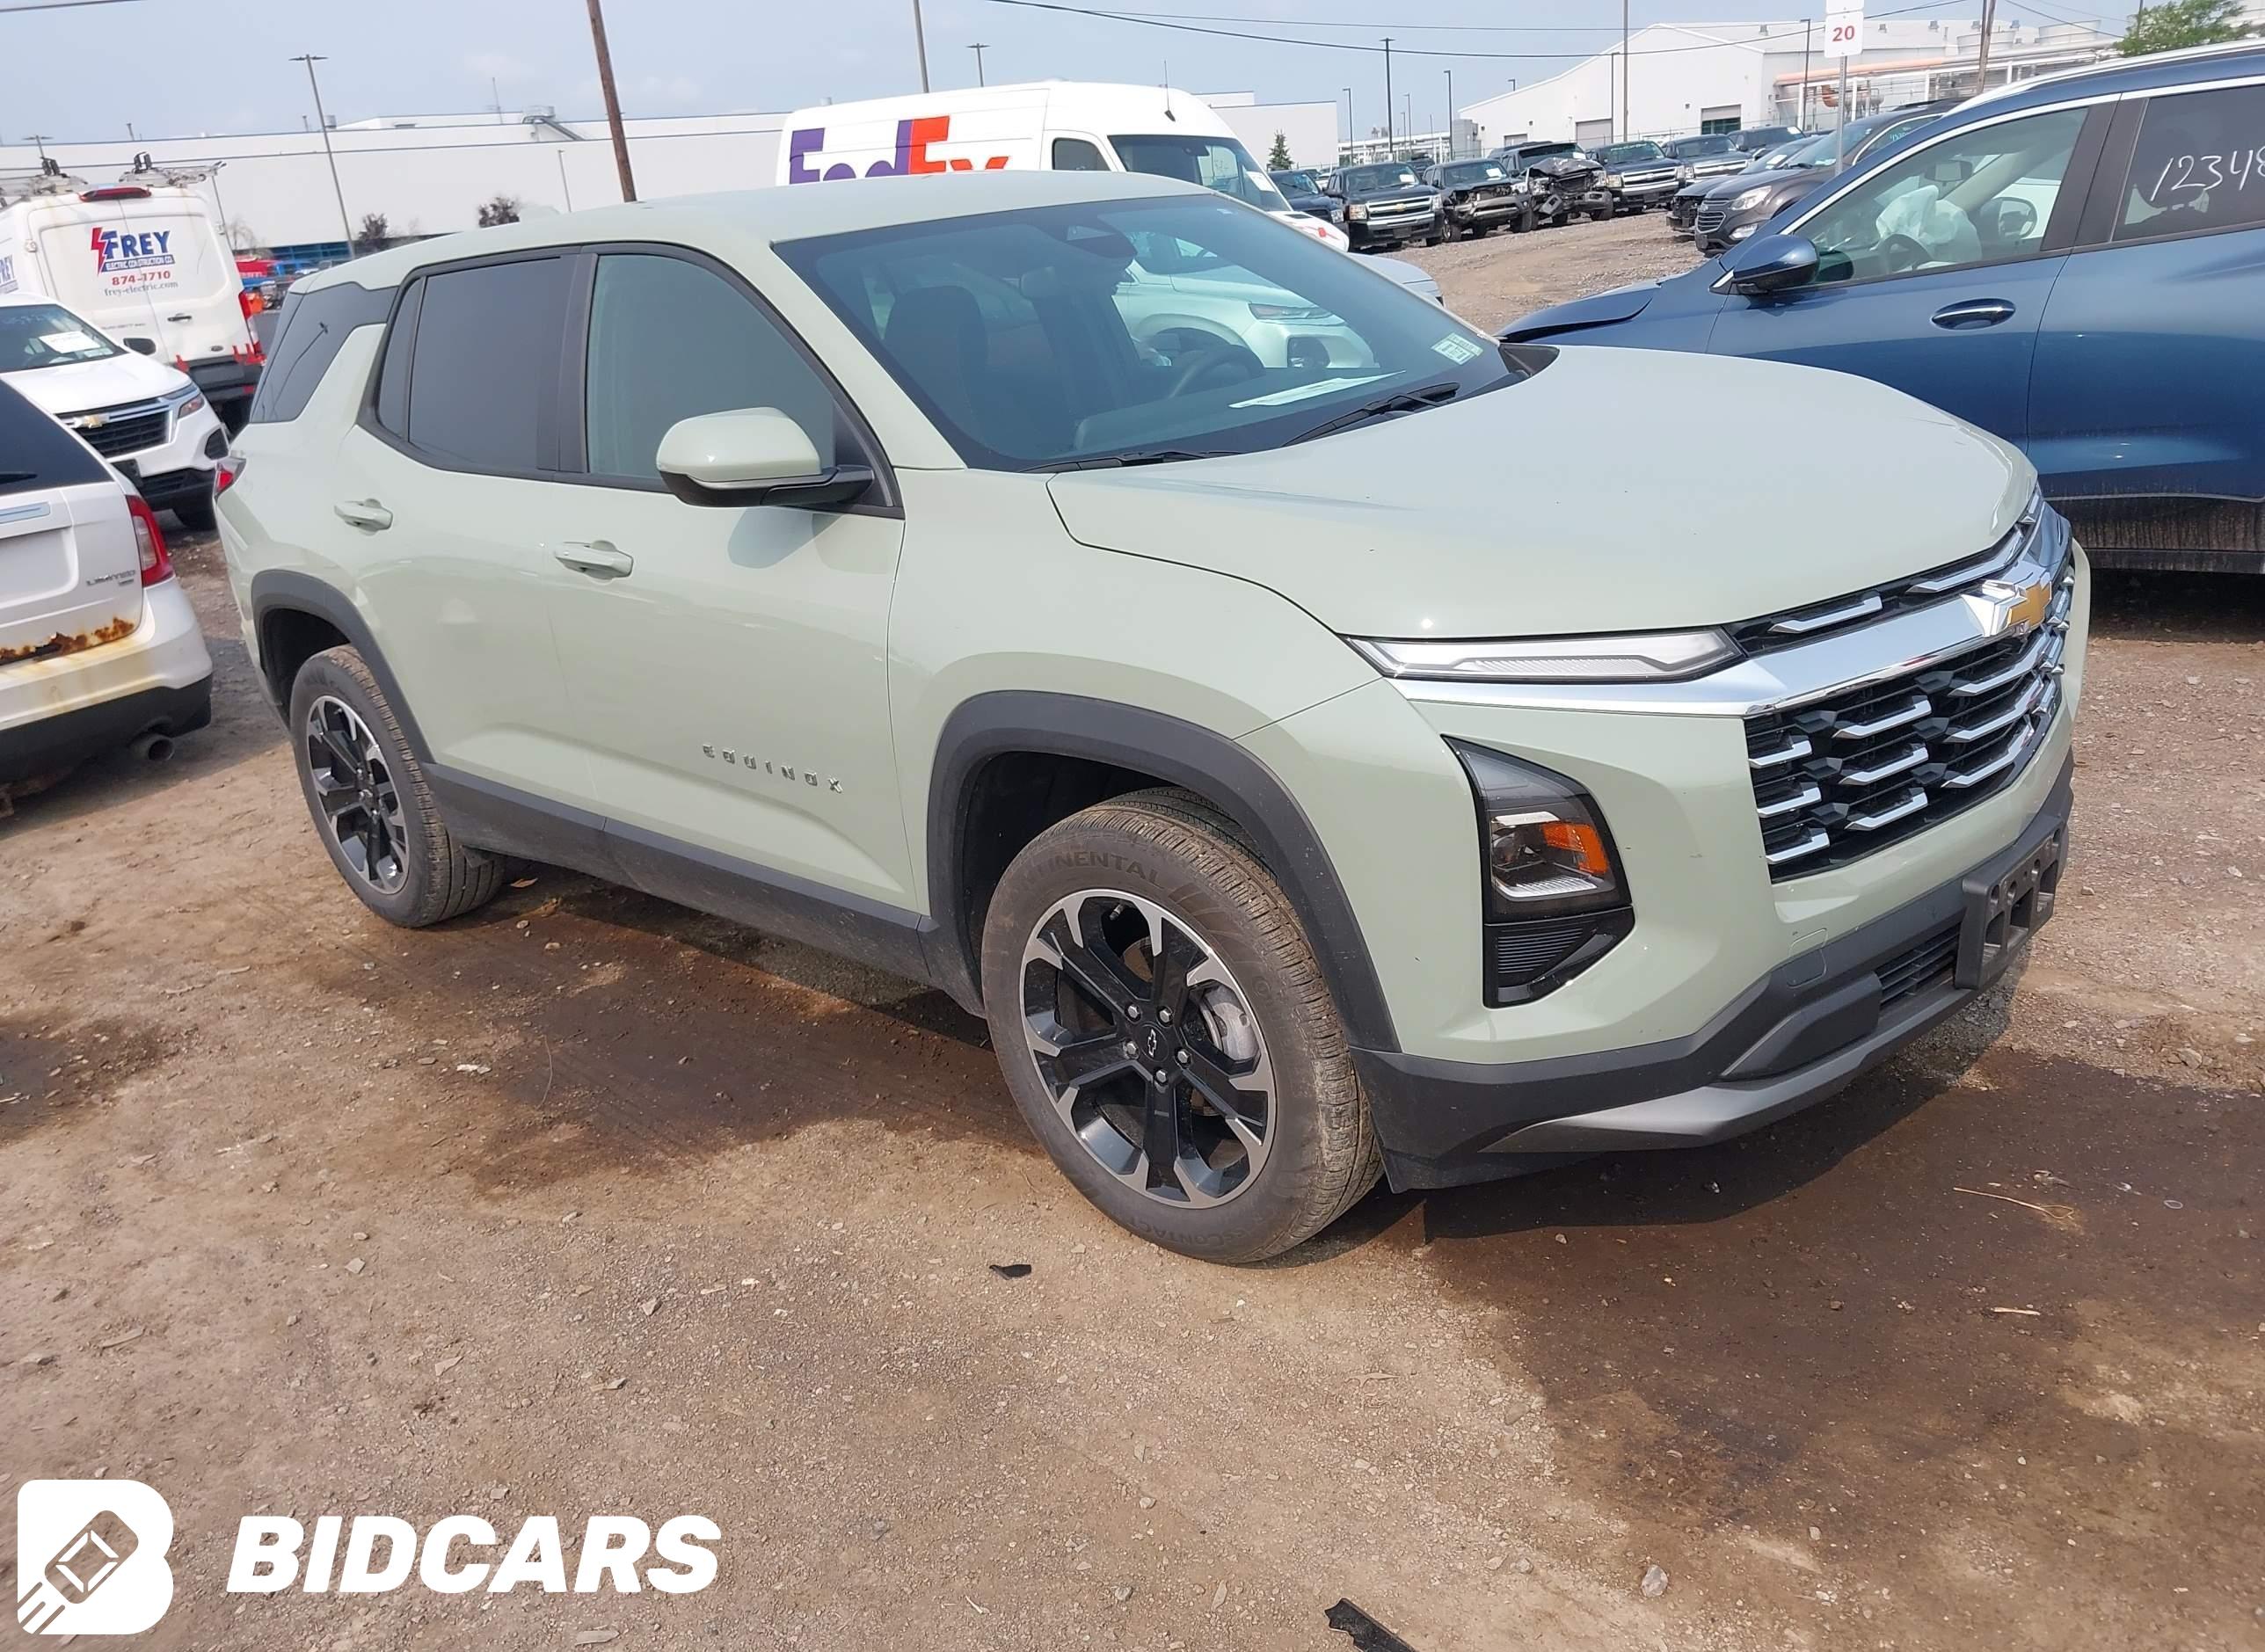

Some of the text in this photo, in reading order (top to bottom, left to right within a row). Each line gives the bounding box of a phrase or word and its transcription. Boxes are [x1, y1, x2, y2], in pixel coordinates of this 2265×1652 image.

[1832, 25, 1855, 42] 20
[790, 115, 1010, 185] FdE
[100, 229, 171, 259] FREY
[104, 280, 178, 296] frey-electric.com
[112, 270, 171, 286] 874-1710
[702, 744, 844, 794] EQUINOX
